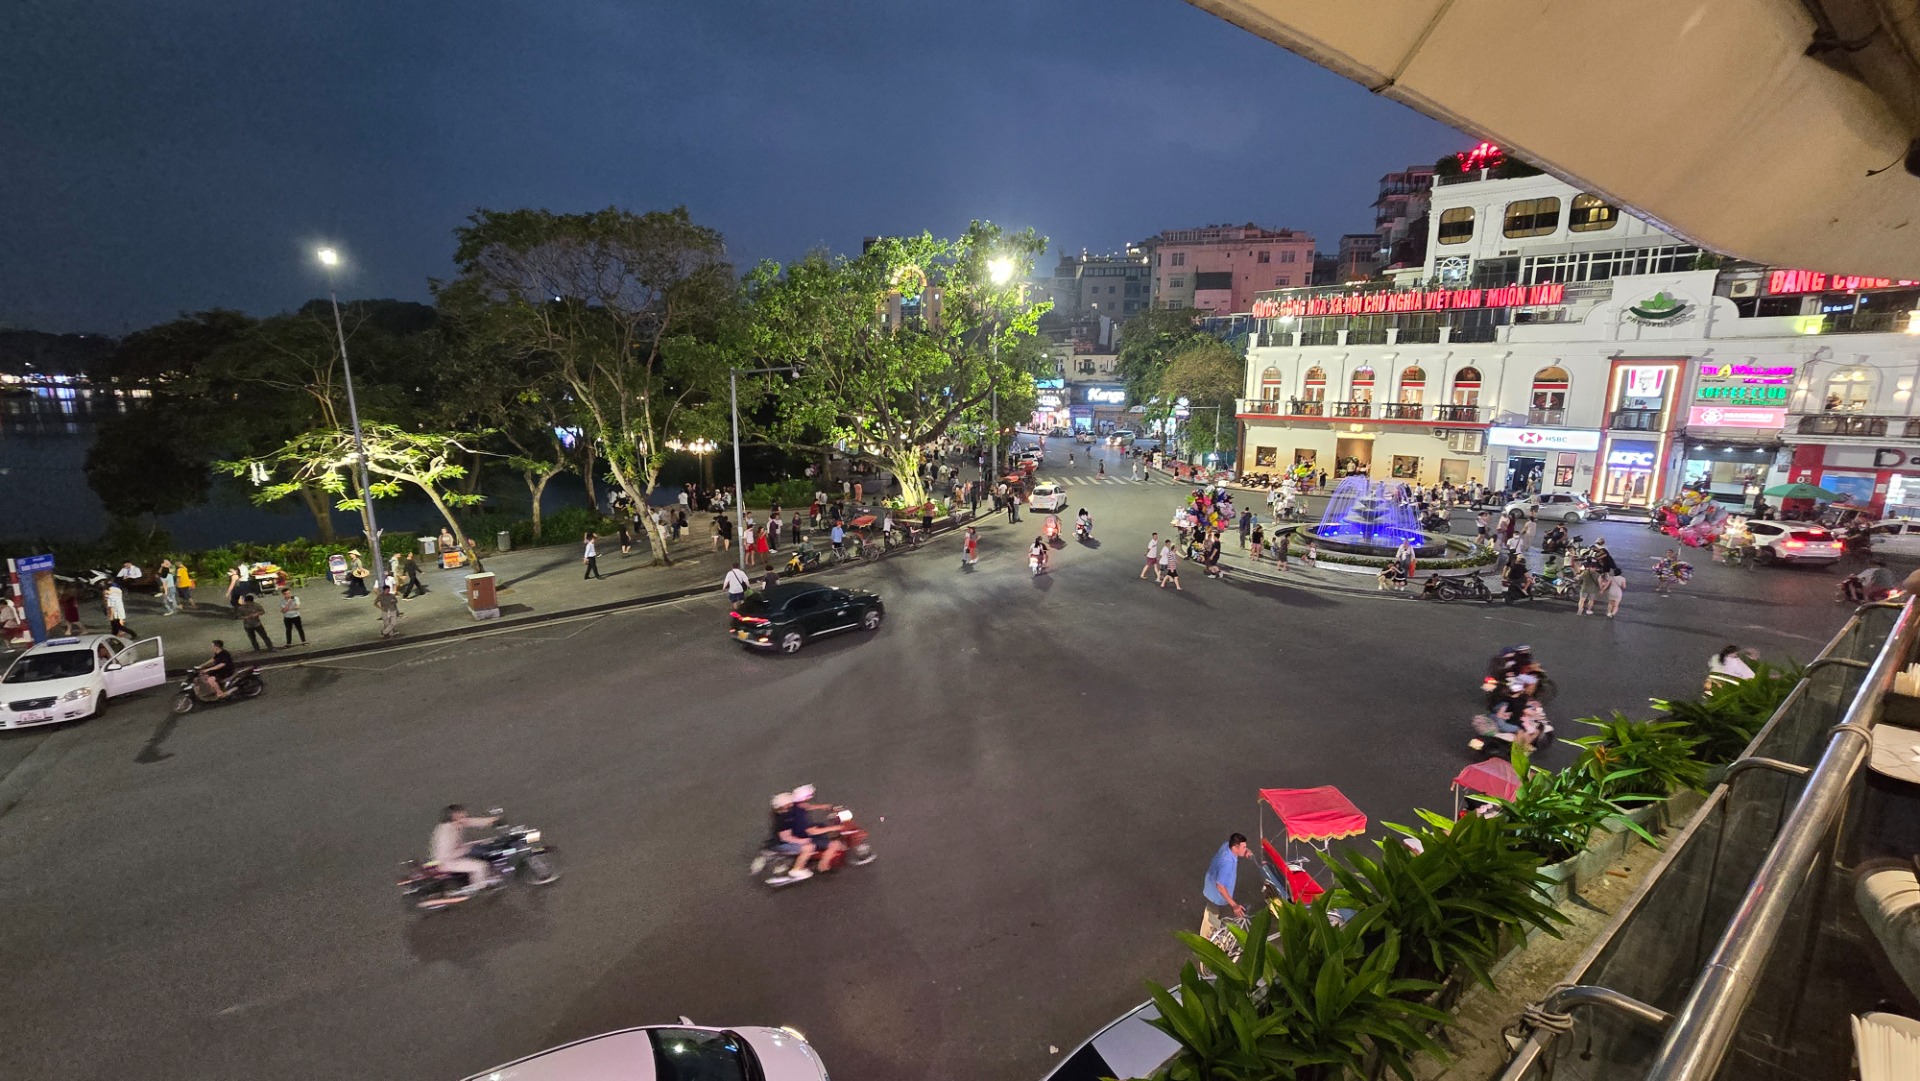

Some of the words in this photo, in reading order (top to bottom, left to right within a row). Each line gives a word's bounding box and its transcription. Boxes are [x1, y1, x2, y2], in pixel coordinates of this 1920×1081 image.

[1345, 292, 1363, 316] HỘI
[1364, 289, 1387, 312] CHỦ
[1387, 289, 1423, 312] NGHĨA
[1425, 287, 1453, 312] VIỆT
[1452, 289, 1483, 309] NAM
[1486, 283, 1527, 307] MUÔN
[1529, 280, 1565, 305] NĂM
[1697, 386, 1747, 399] COFFEE
[1751, 386, 1787, 399] CLUB
[1607, 451, 1654, 466] KFC
